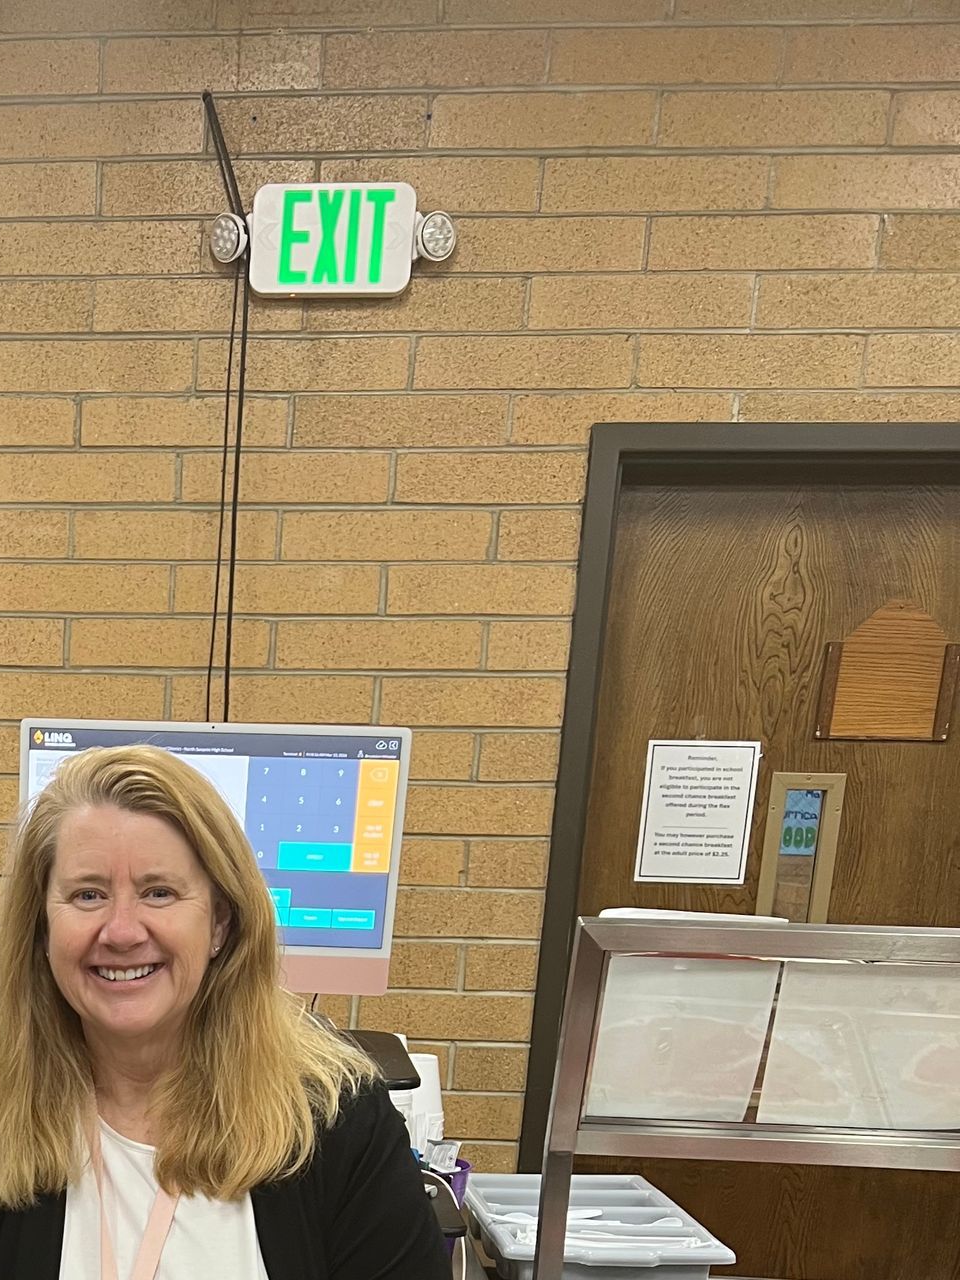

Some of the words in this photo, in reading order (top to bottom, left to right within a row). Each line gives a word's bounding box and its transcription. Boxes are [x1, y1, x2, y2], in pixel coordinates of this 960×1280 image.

[279, 189, 395, 284] EXIT
[45, 732, 72, 743] LINQ
[301, 768, 306, 776] 8
[338, 769, 344, 777] 9
[299, 796, 304, 804] 5
[336, 798, 341, 806] 6
[333, 825, 339, 833] 3
